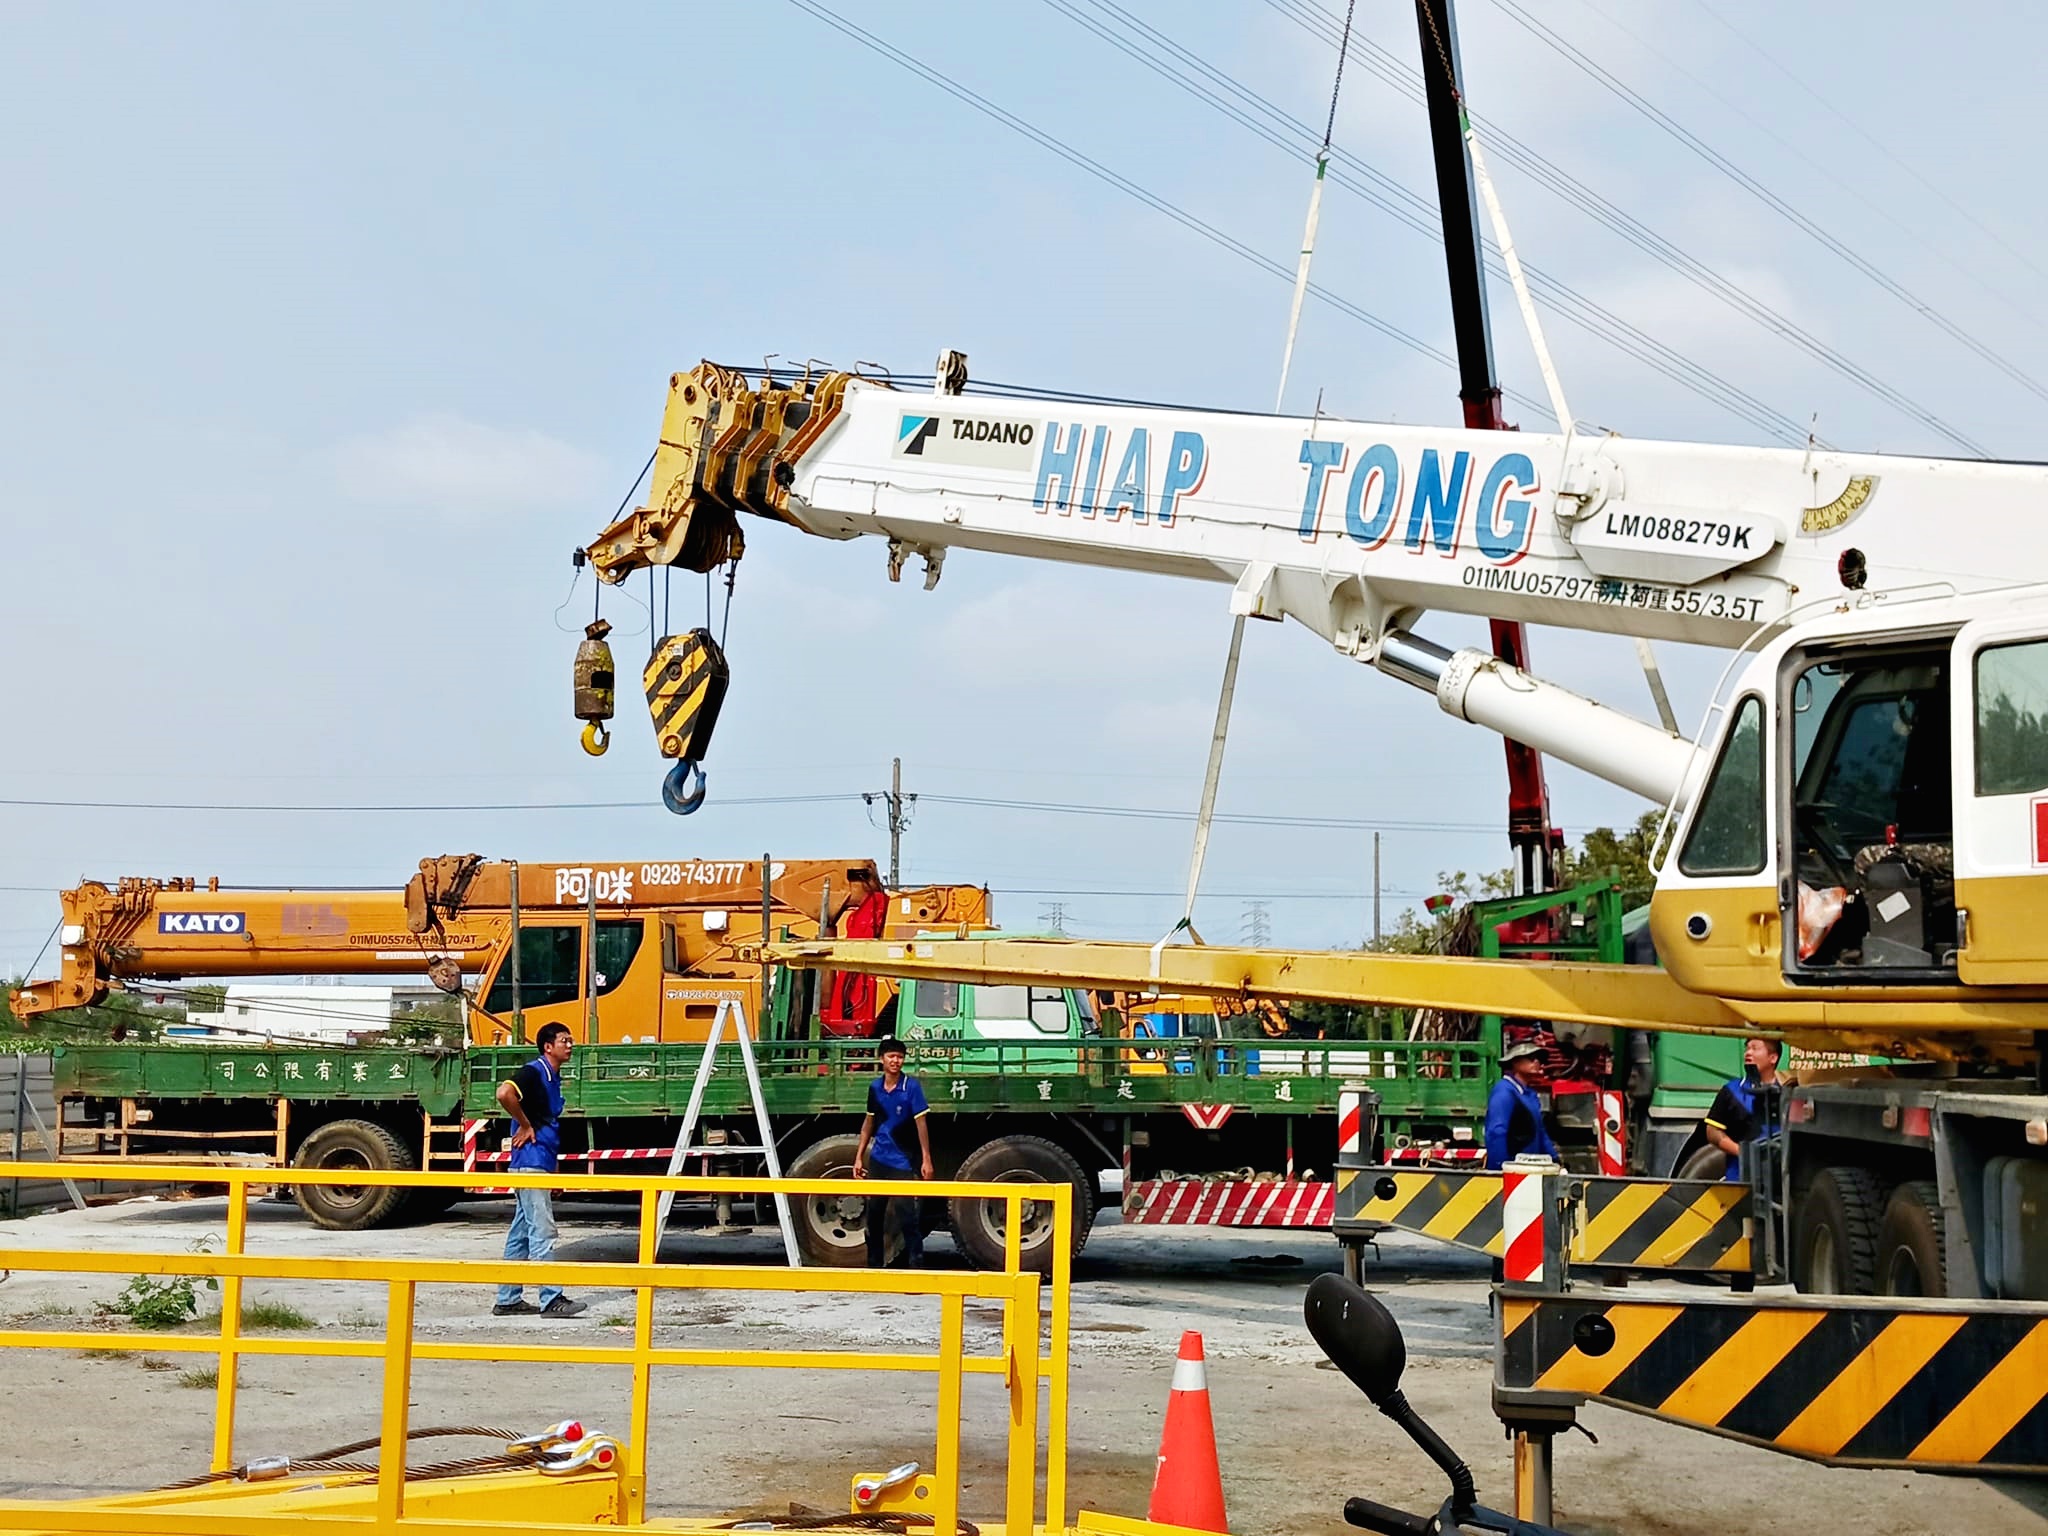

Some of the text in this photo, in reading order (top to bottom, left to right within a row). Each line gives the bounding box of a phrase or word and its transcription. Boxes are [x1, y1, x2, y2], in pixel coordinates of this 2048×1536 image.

[952, 419, 1034, 445] TADANO
[1033, 421, 1541, 567] HIAP TONG
[1606, 512, 1754, 550] LM088279K
[1816, 520, 1830, 532] 20
[555, 867, 634, 904] 阿咪
[640, 863, 745, 885] 0928-743777
[164, 914, 240, 932] KATO
